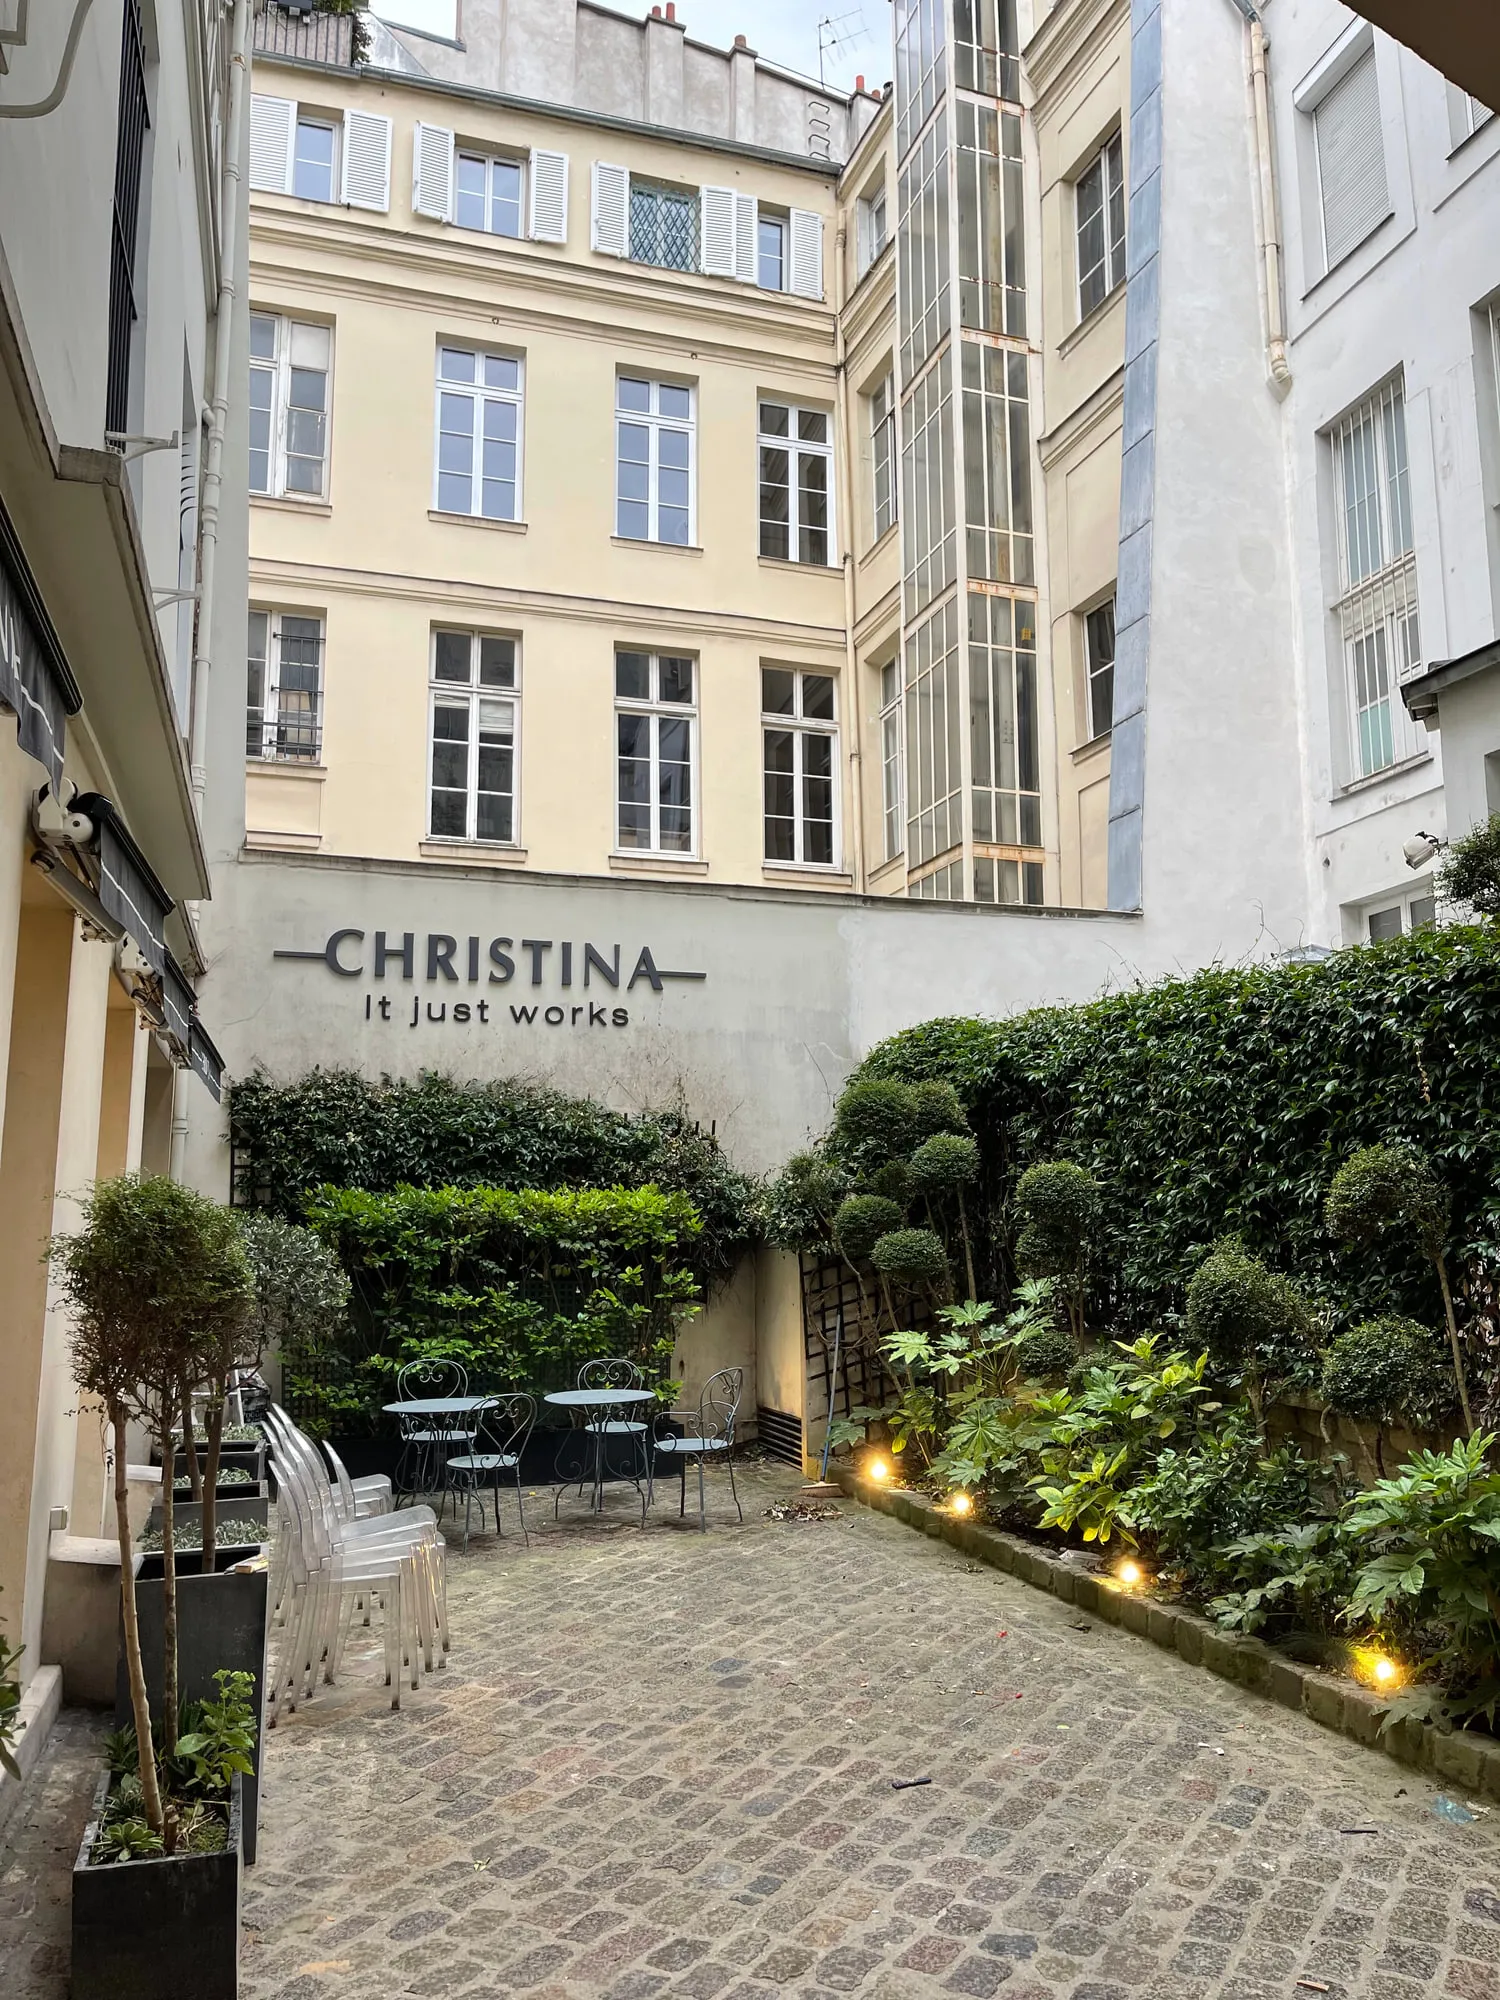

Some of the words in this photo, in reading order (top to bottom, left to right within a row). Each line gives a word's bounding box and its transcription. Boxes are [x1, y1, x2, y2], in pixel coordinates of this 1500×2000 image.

[325, 928, 664, 991] CHRISTINA
[365, 994, 392, 1020] It
[410, 995, 489, 1028] just
[509, 1001, 629, 1027] works
